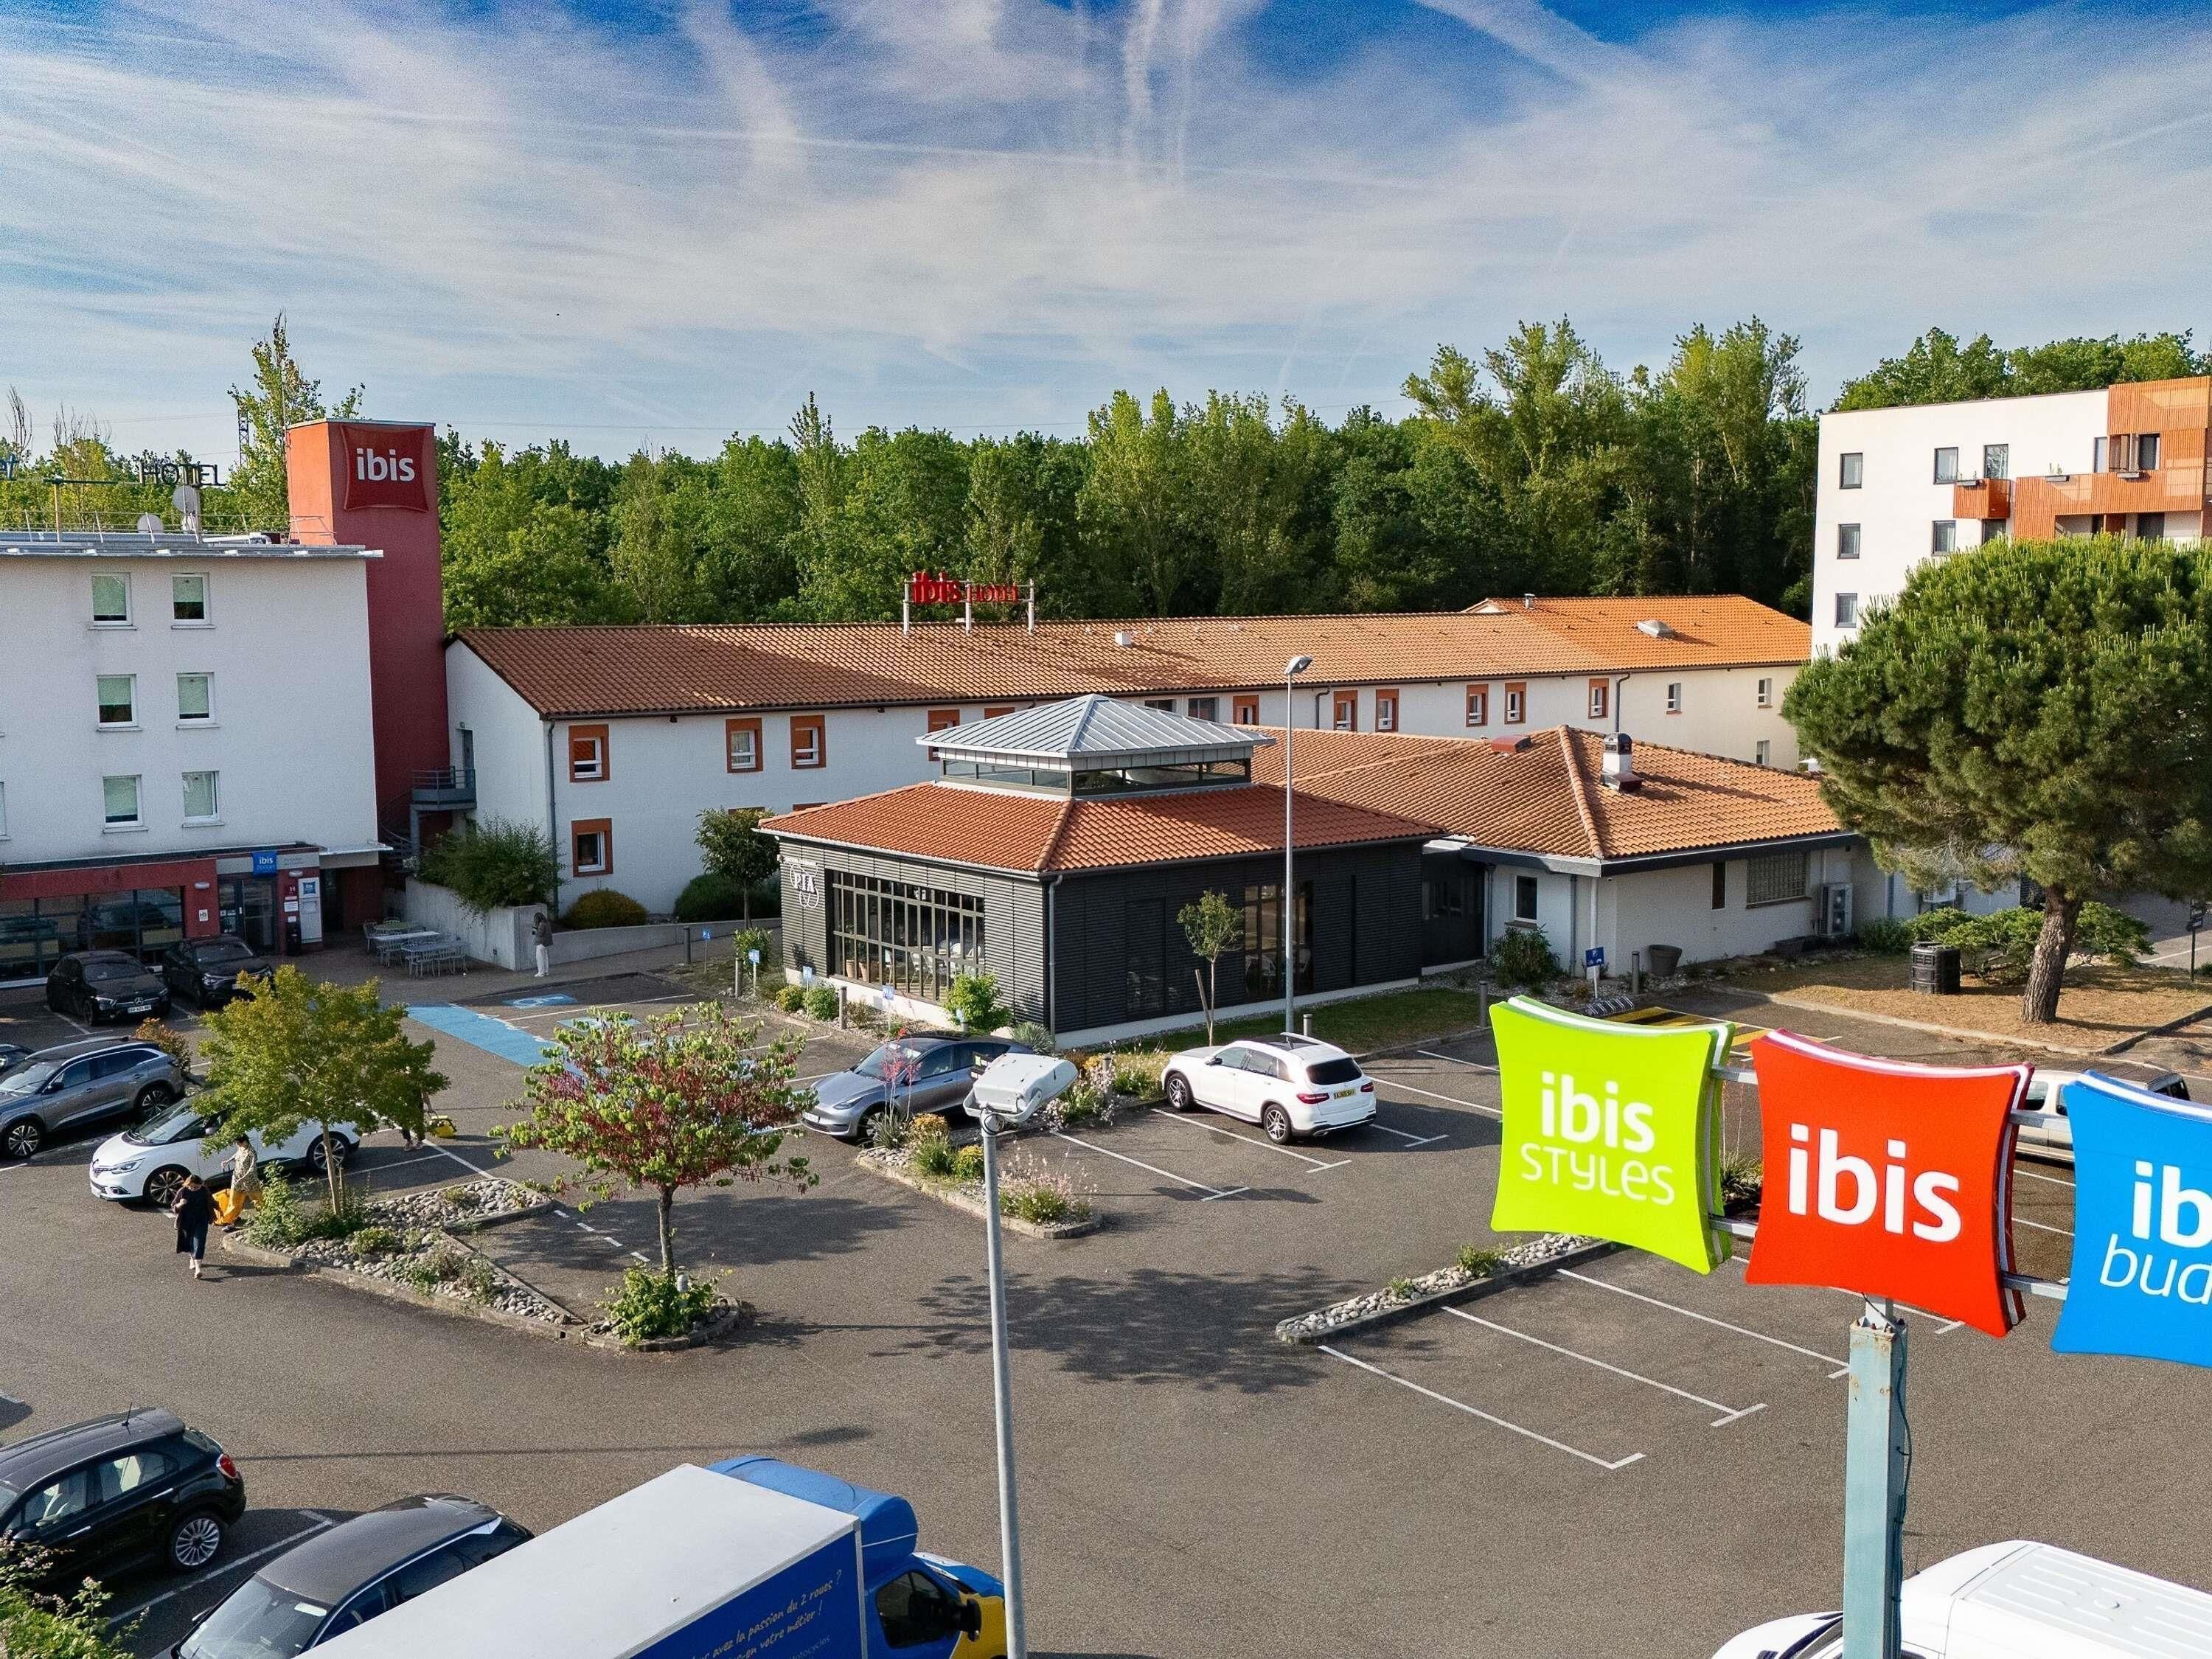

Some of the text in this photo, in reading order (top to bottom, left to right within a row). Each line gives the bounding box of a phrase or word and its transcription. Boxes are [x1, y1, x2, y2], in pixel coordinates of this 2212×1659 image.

[356, 448, 415, 481] ibis
[912, 571, 961, 604] ibis
[259, 855, 274, 864] ibis
[1541, 1071, 1655, 1153] ibis
[1788, 1122, 1962, 1242] ibis
[737, 1629, 746, 1644] la
[748, 1610, 785, 1642] passion
[786, 1599, 798, 1614] du
[801, 1593, 807, 1606] 2
[809, 1580, 834, 1601] roues
[759, 1628, 785, 1649] votre
[786, 1610, 815, 1634] métier
